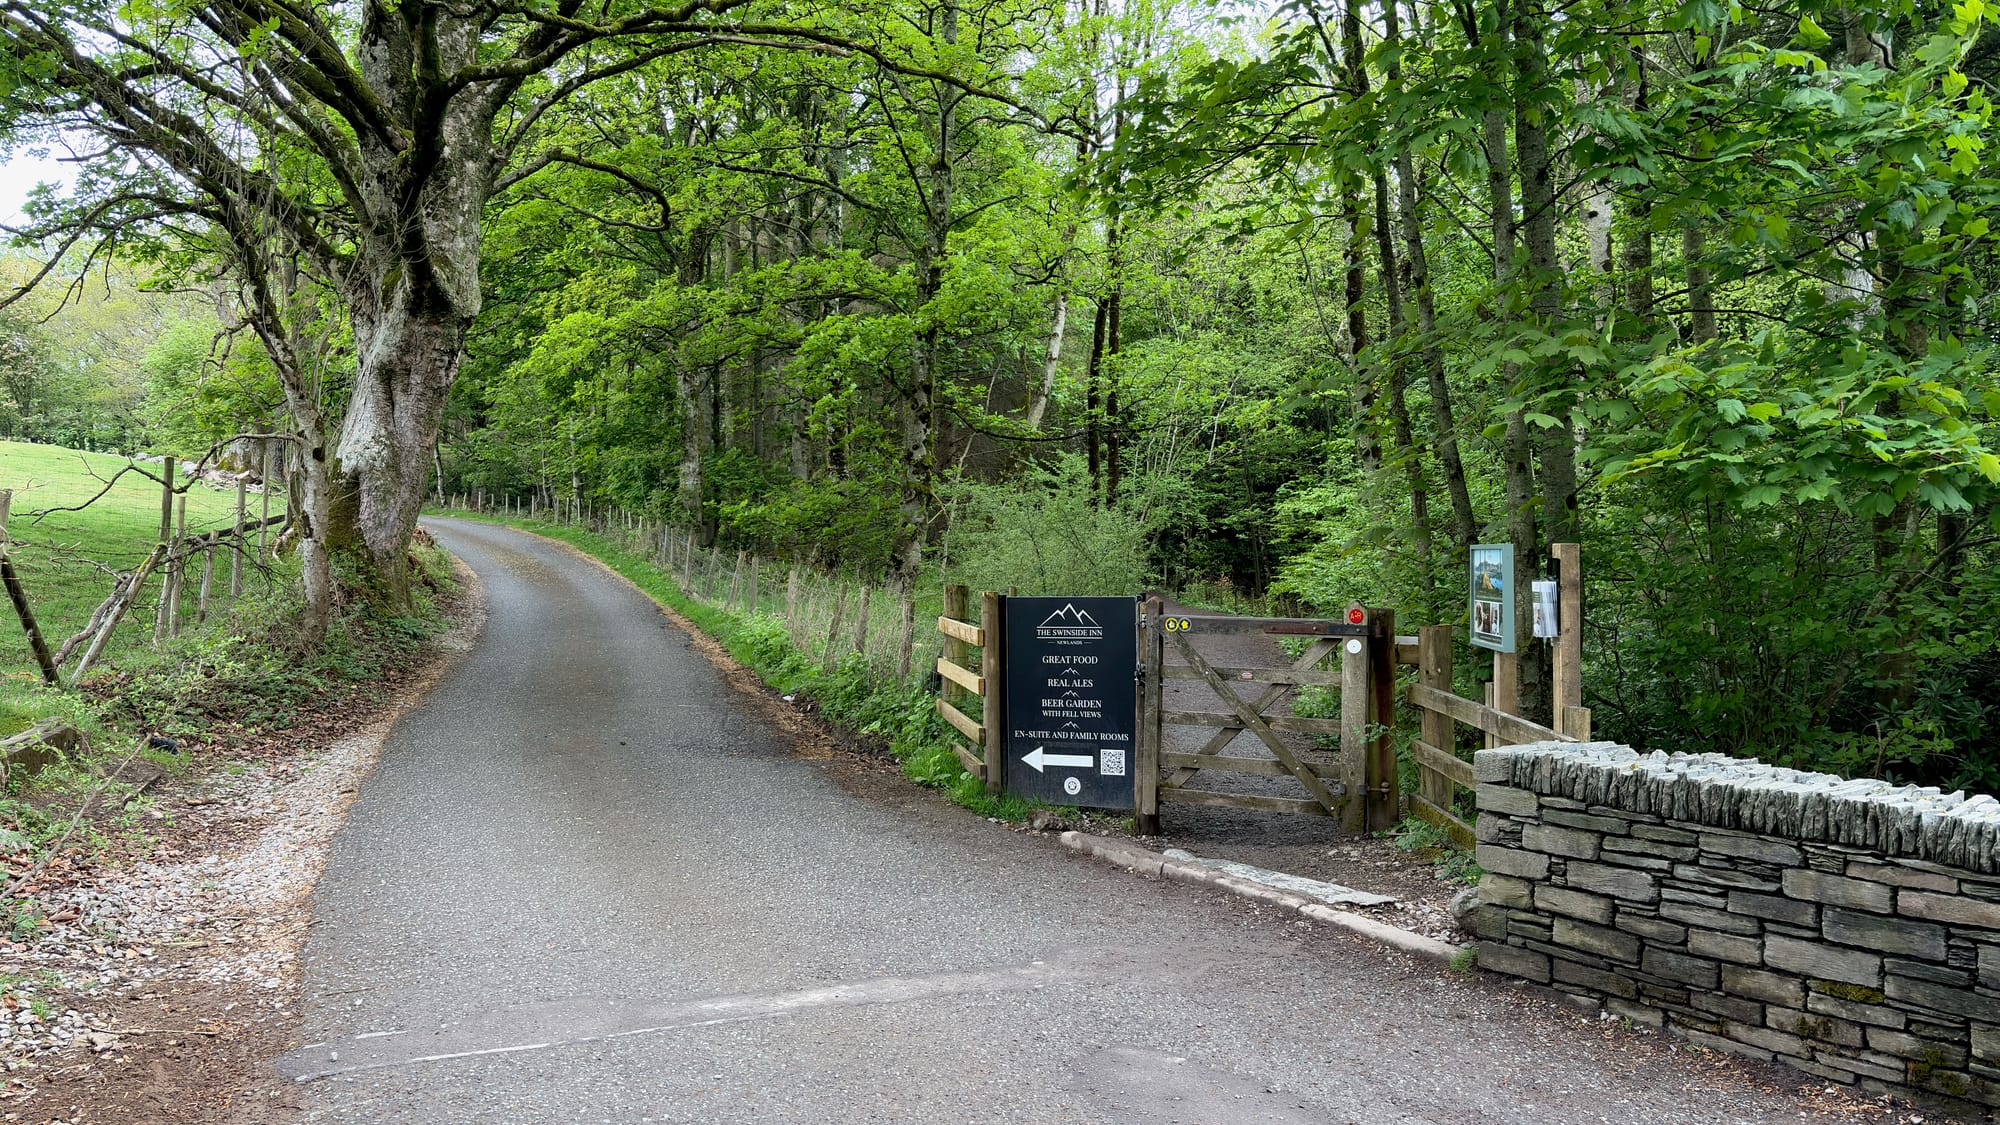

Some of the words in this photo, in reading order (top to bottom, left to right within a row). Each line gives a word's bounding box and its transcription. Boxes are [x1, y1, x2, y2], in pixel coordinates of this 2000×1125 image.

[1089, 629, 1102, 637] INN
[1042, 656, 1071, 664] GREAT
[1073, 656, 1098, 664] FOOD
[1048, 679, 1069, 687] REAL
[1072, 679, 1093, 688] ALES
[1042, 699, 1063, 707] BEER
[1066, 699, 1101, 708] GARDEN
[1015, 730, 1050, 739] EN-SUITE
[1052, 731, 1068, 739] AND
[1070, 731, 1098, 741] FAMILY
[1101, 733, 1128, 741] ROOMS
